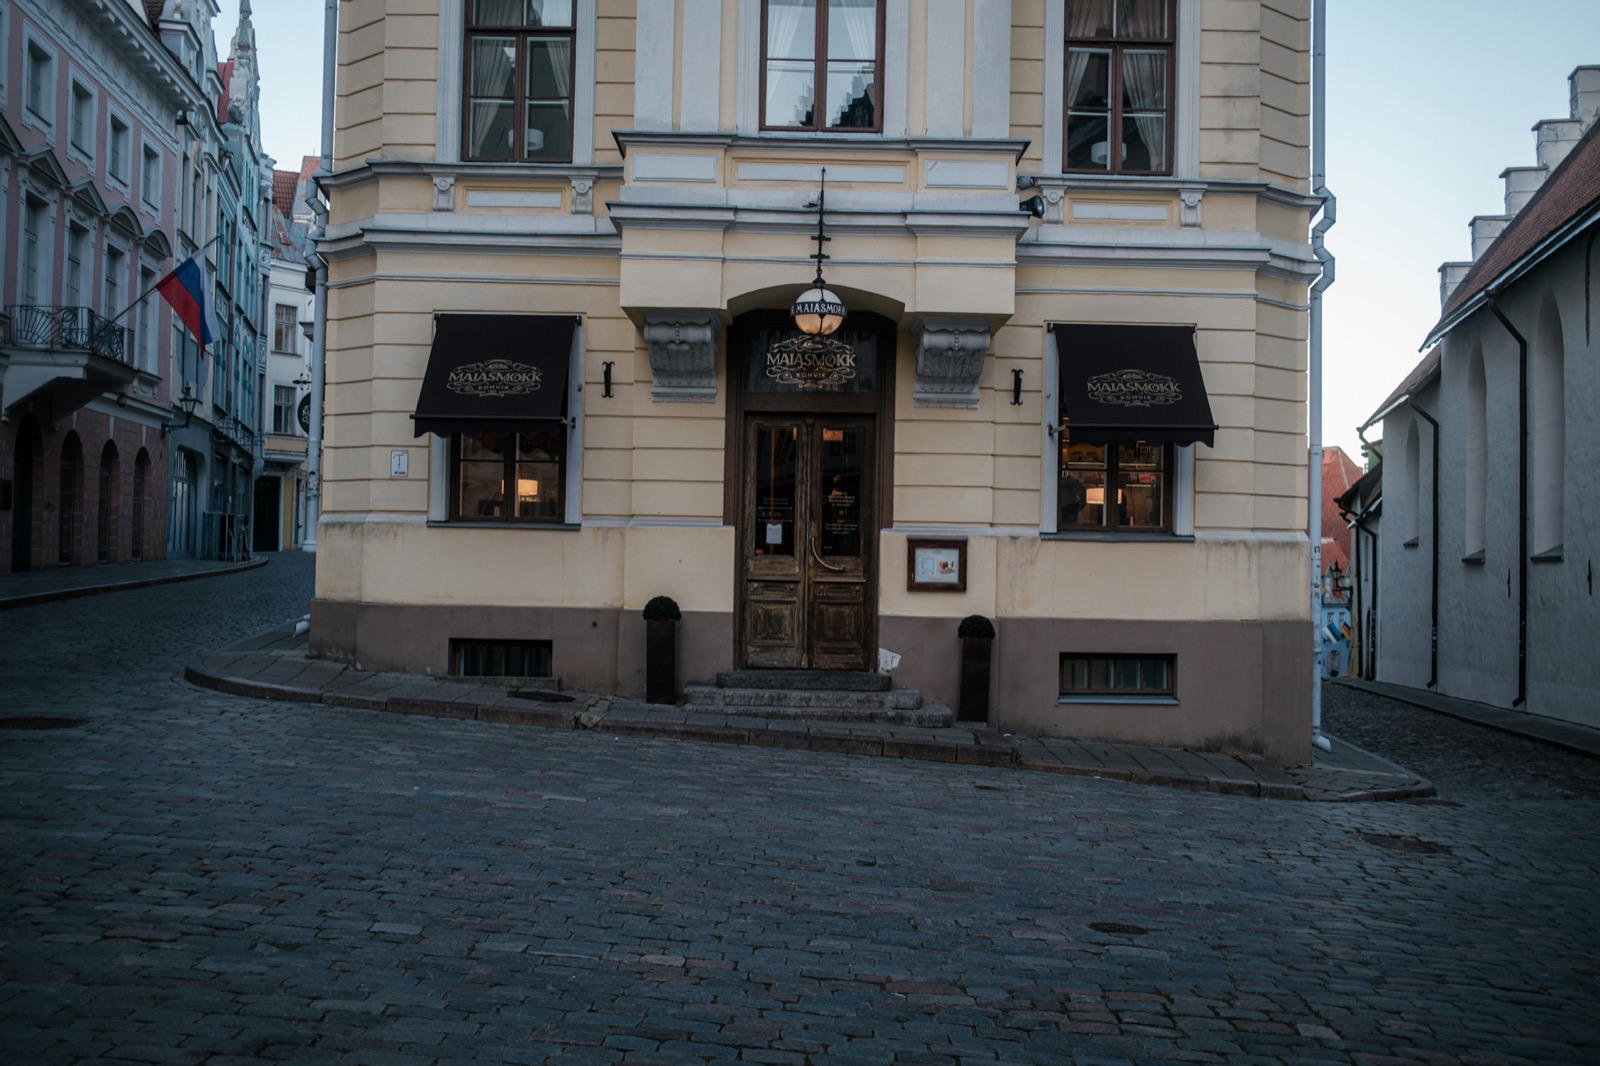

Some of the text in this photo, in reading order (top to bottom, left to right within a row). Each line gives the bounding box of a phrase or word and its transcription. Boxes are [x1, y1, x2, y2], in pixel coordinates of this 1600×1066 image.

[766, 352, 857, 367] MAIASMOKK
[448, 370, 543, 383] MAIASMOKK
[1086, 381, 1182, 393] MAIASMOKK
